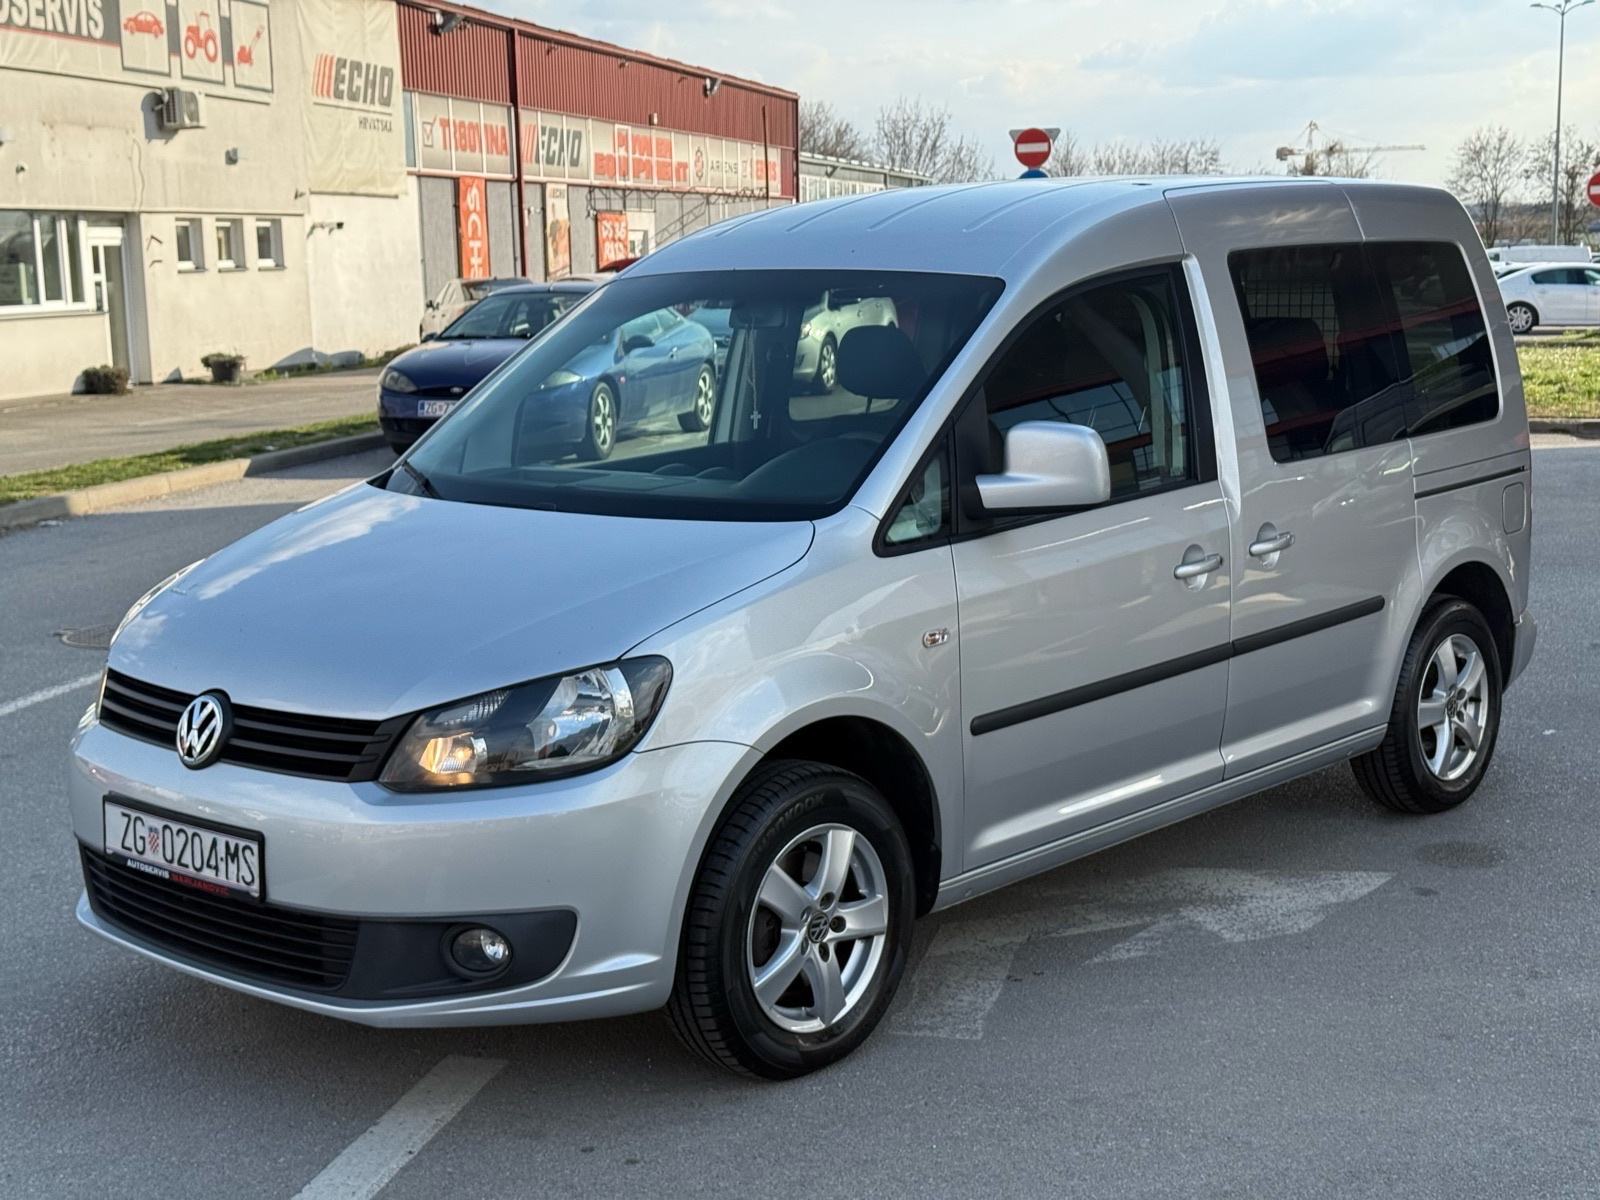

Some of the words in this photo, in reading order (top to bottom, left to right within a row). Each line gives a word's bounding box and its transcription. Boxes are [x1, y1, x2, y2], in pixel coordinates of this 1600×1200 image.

[333, 57, 394, 108] ECHO
[535, 124, 583, 168] ECHO
[120, 811, 146, 856] ZG
